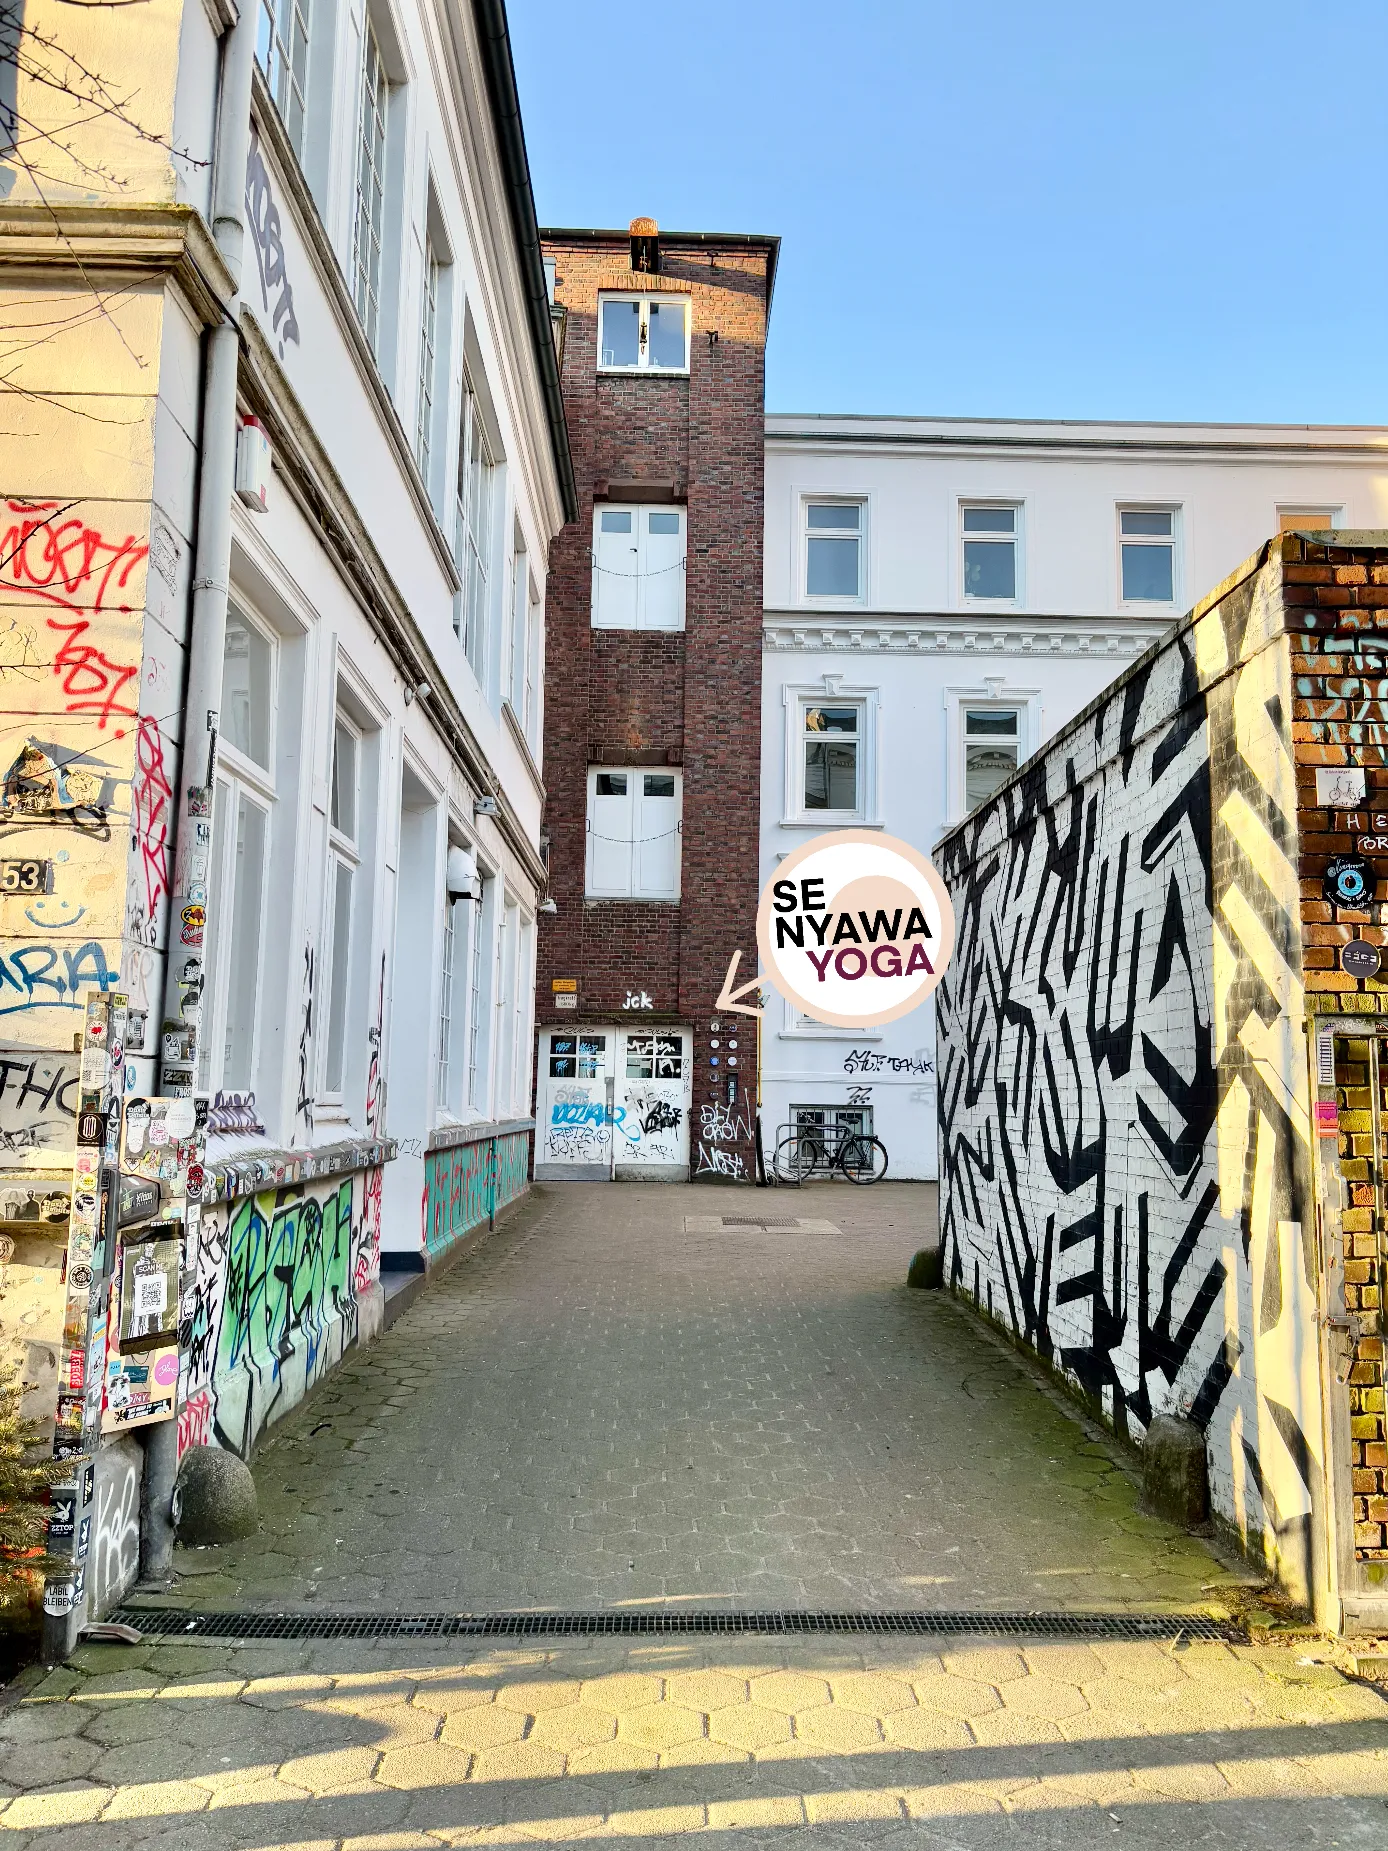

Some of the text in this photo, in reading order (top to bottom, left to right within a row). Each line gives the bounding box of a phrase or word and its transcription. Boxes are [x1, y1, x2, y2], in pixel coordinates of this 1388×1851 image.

[1, 861, 39, 890] 53
[138, 1263, 155, 1273] SCAN
[49, 1586, 68, 1596] LABIL
